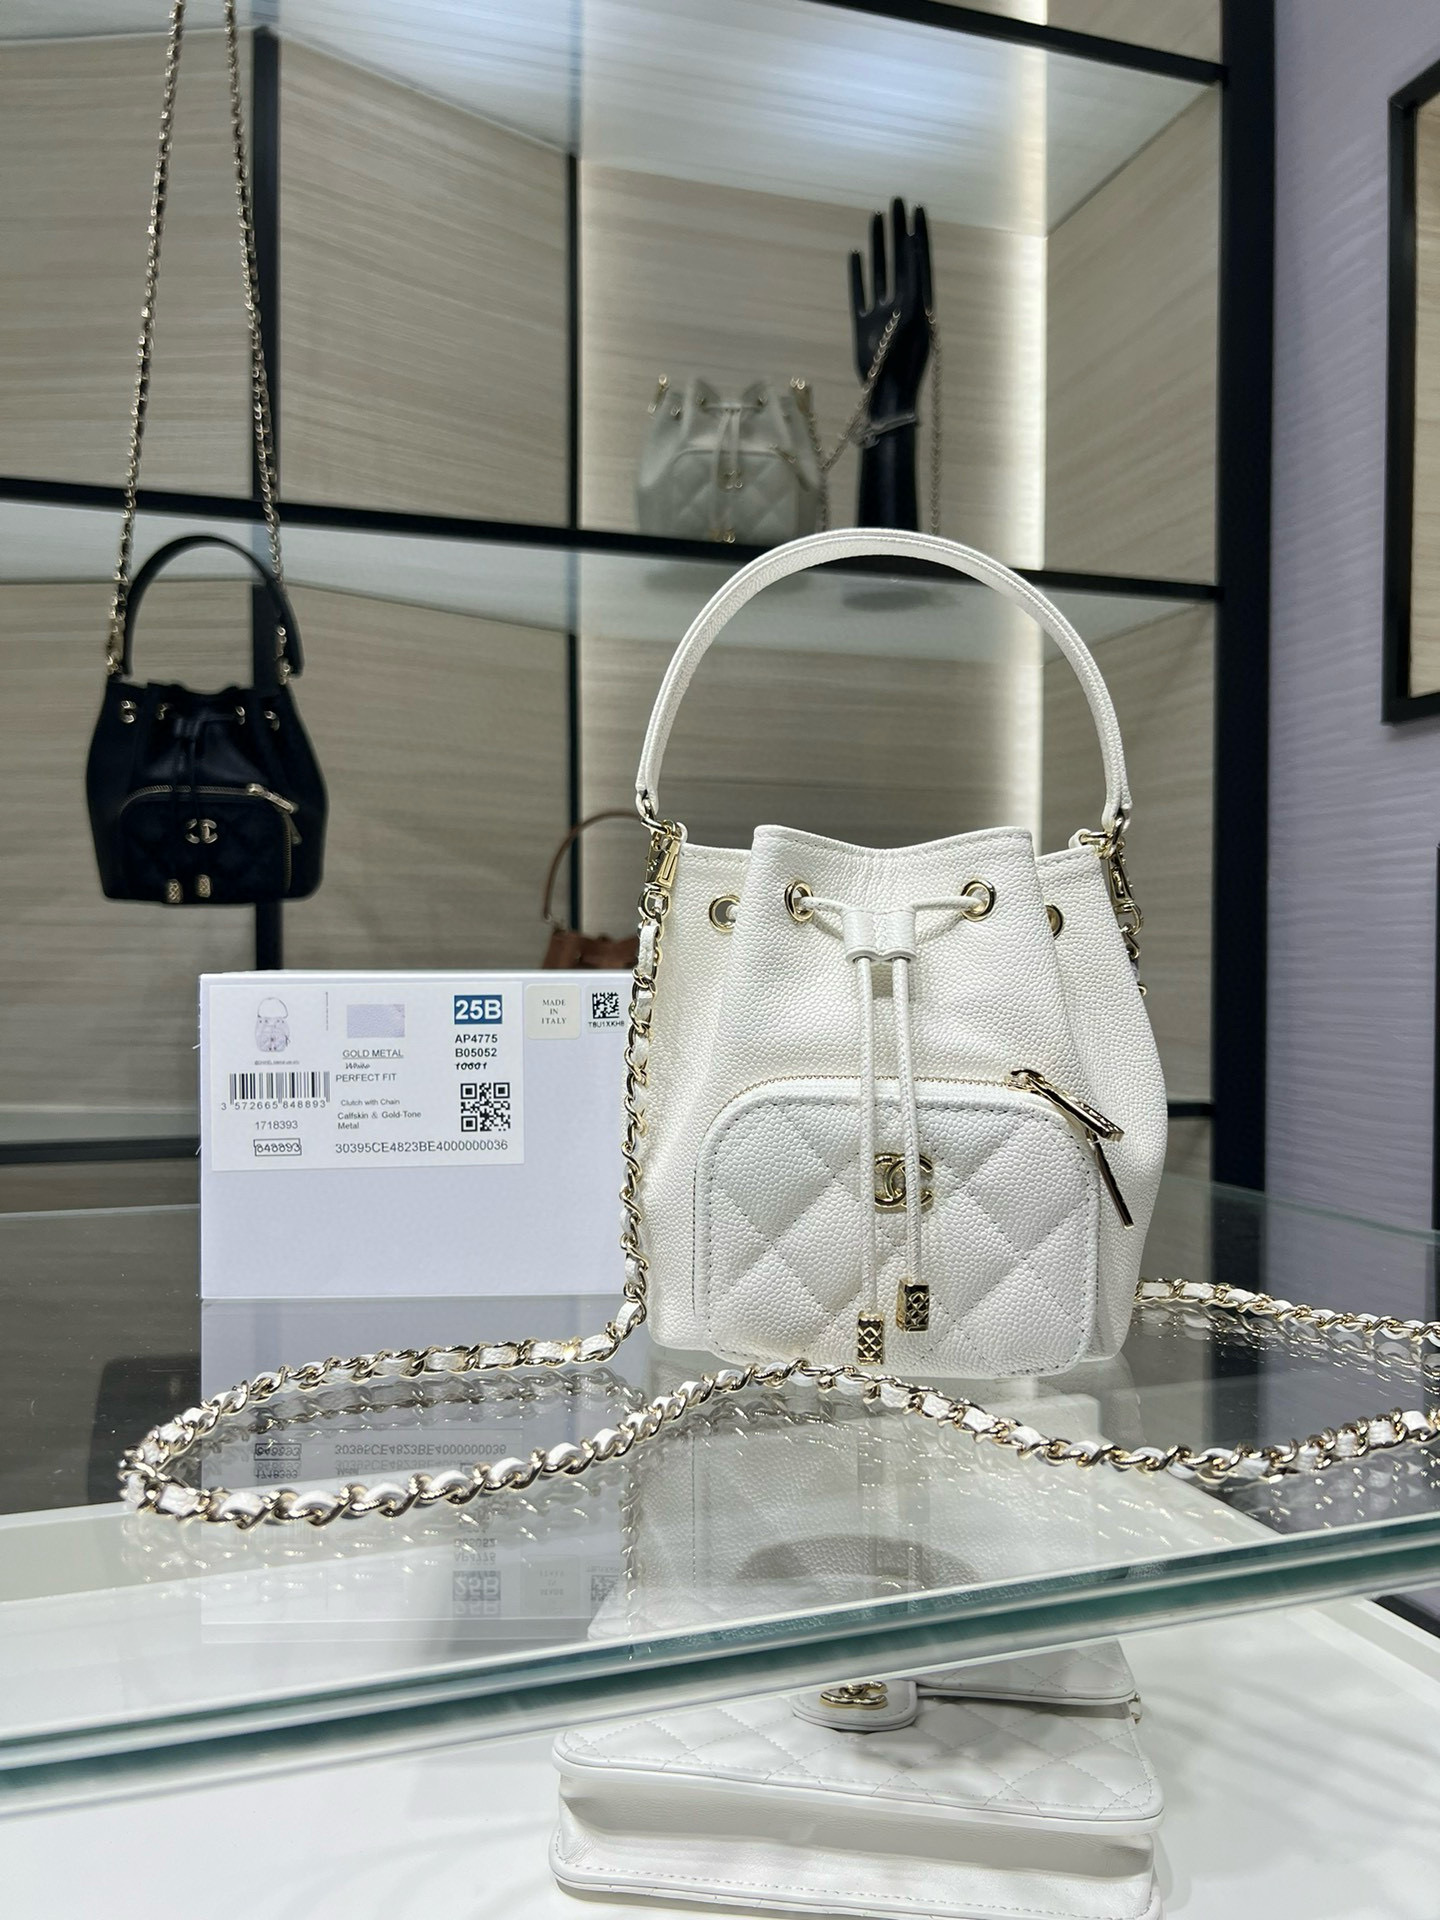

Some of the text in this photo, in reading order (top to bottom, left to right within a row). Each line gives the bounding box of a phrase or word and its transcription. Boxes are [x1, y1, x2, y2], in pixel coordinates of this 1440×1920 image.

[542, 999, 567, 1007] MADE
[455, 999, 502, 1020] 25B
[541, 1017, 567, 1025] ITALY
[454, 1033, 498, 1043] AP4775
[342, 1048, 404, 1058] GOLD METAL
[455, 1047, 498, 1058] B05052
[335, 1072, 397, 1083] PERFECT FIT
[220, 1102, 227, 1111] 3
[340, 1097, 400, 1107] Clutch with Chain
[337, 1110, 422, 1120] Calfskin & Gold-Tone
[255, 1119, 299, 1130] 1718393
[337, 1121, 360, 1130] Metal
[255, 1142, 301, 1153] 848893
[335, 1139, 509, 1154] 30395CE4823BE4000000036
